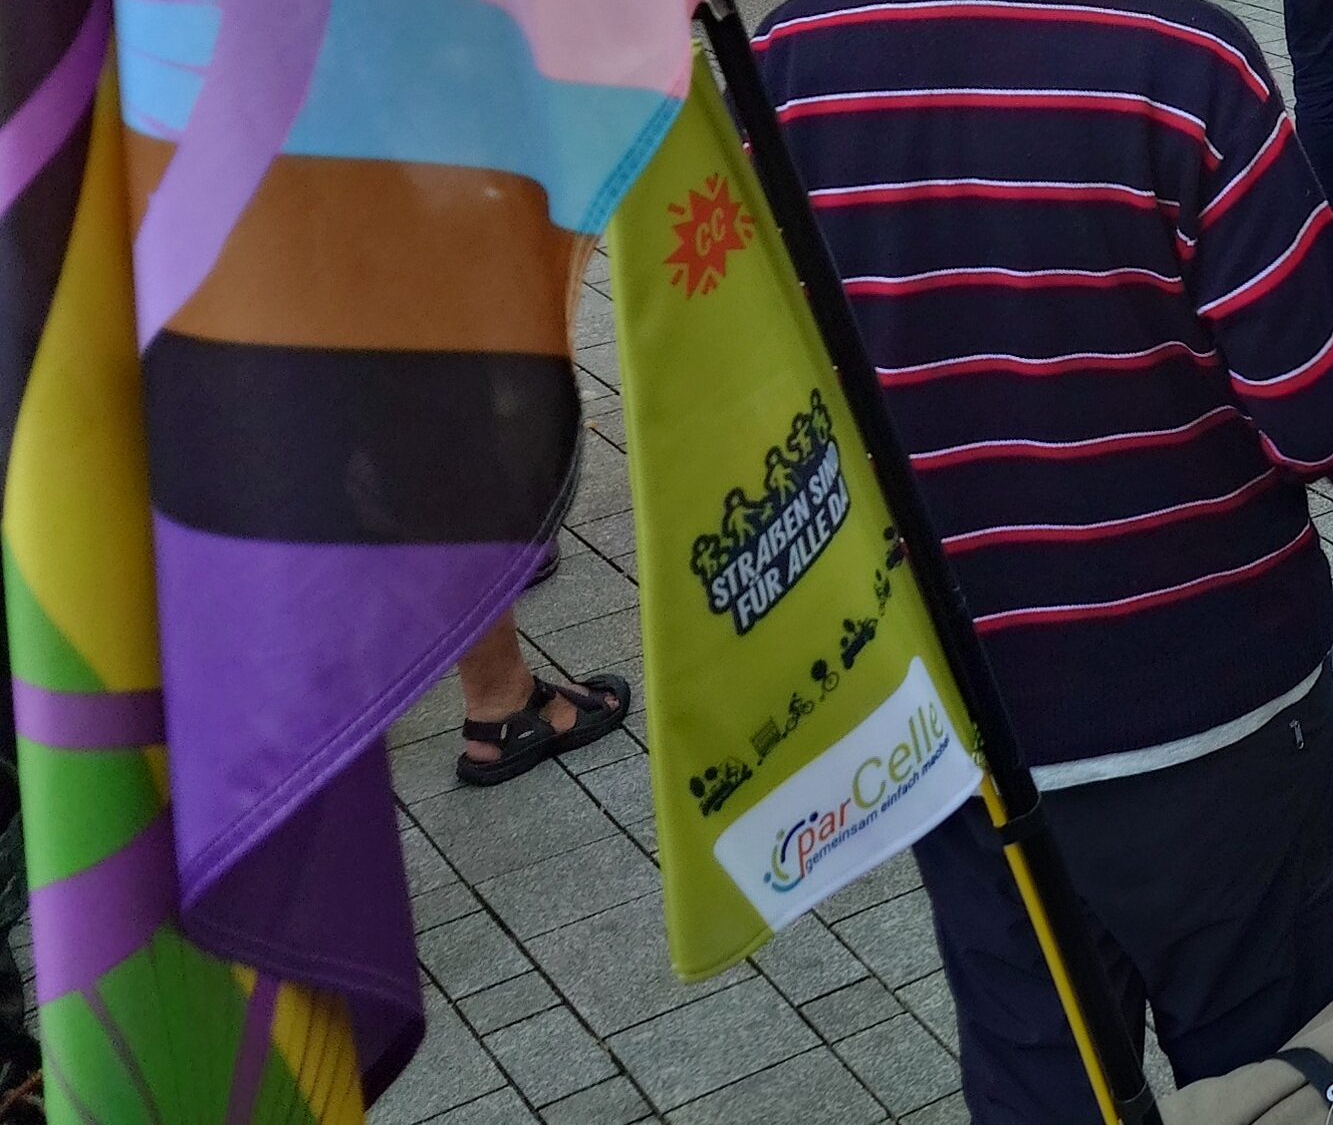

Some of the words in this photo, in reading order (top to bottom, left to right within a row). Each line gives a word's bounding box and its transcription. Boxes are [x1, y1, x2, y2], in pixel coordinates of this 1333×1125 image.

[694, 207, 728, 257] CC
[712, 497, 809, 612] STRAßEN
[735, 568, 785, 634] FÜR
[787, 515, 830, 585] ALLE
[797, 701, 945, 880] parCelle
[805, 811, 878, 874] gemeinsam
[880, 771, 921, 813] einfach
